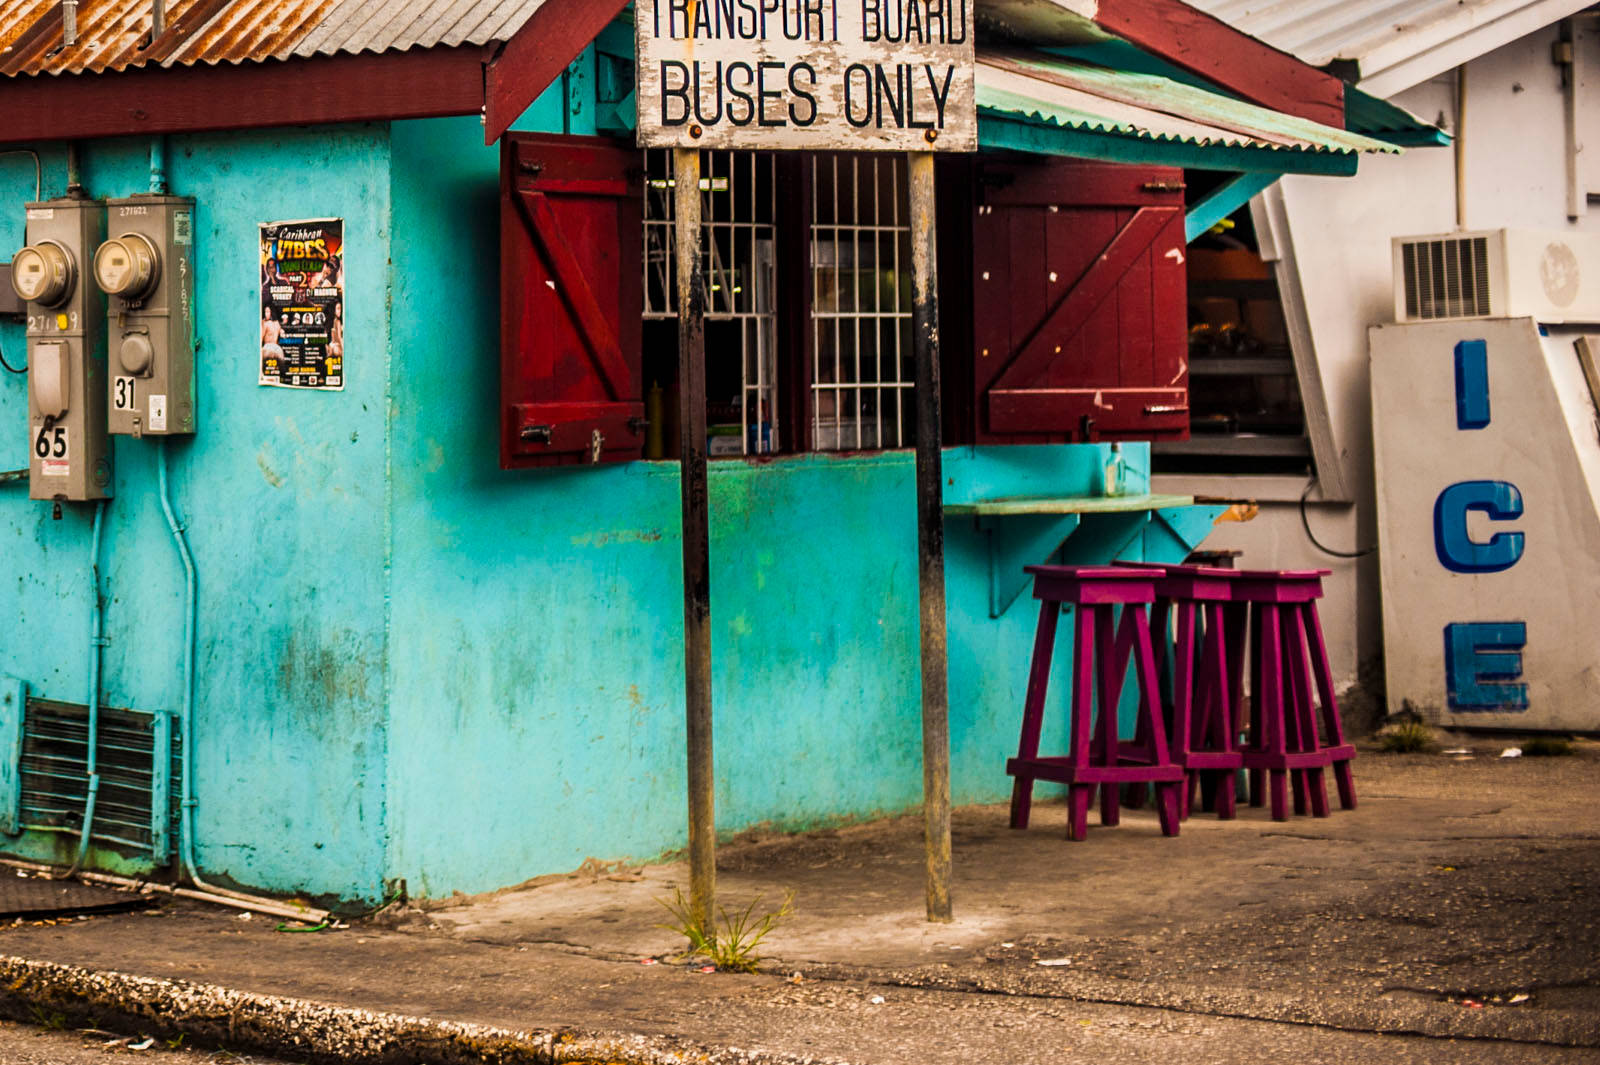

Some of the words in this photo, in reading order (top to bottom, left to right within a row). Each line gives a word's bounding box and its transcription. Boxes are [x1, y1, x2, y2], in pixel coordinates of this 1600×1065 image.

[660, 59, 817, 127] BUSES
[844, 63, 955, 129] ONLY
[279, 227, 322, 240] Caribbean
[277, 239, 329, 260] VIBES
[299, 272, 308, 287] 2
[116, 378, 135, 409] 31
[36, 428, 66, 458] 65
[1433, 338, 1531, 714] ICE
